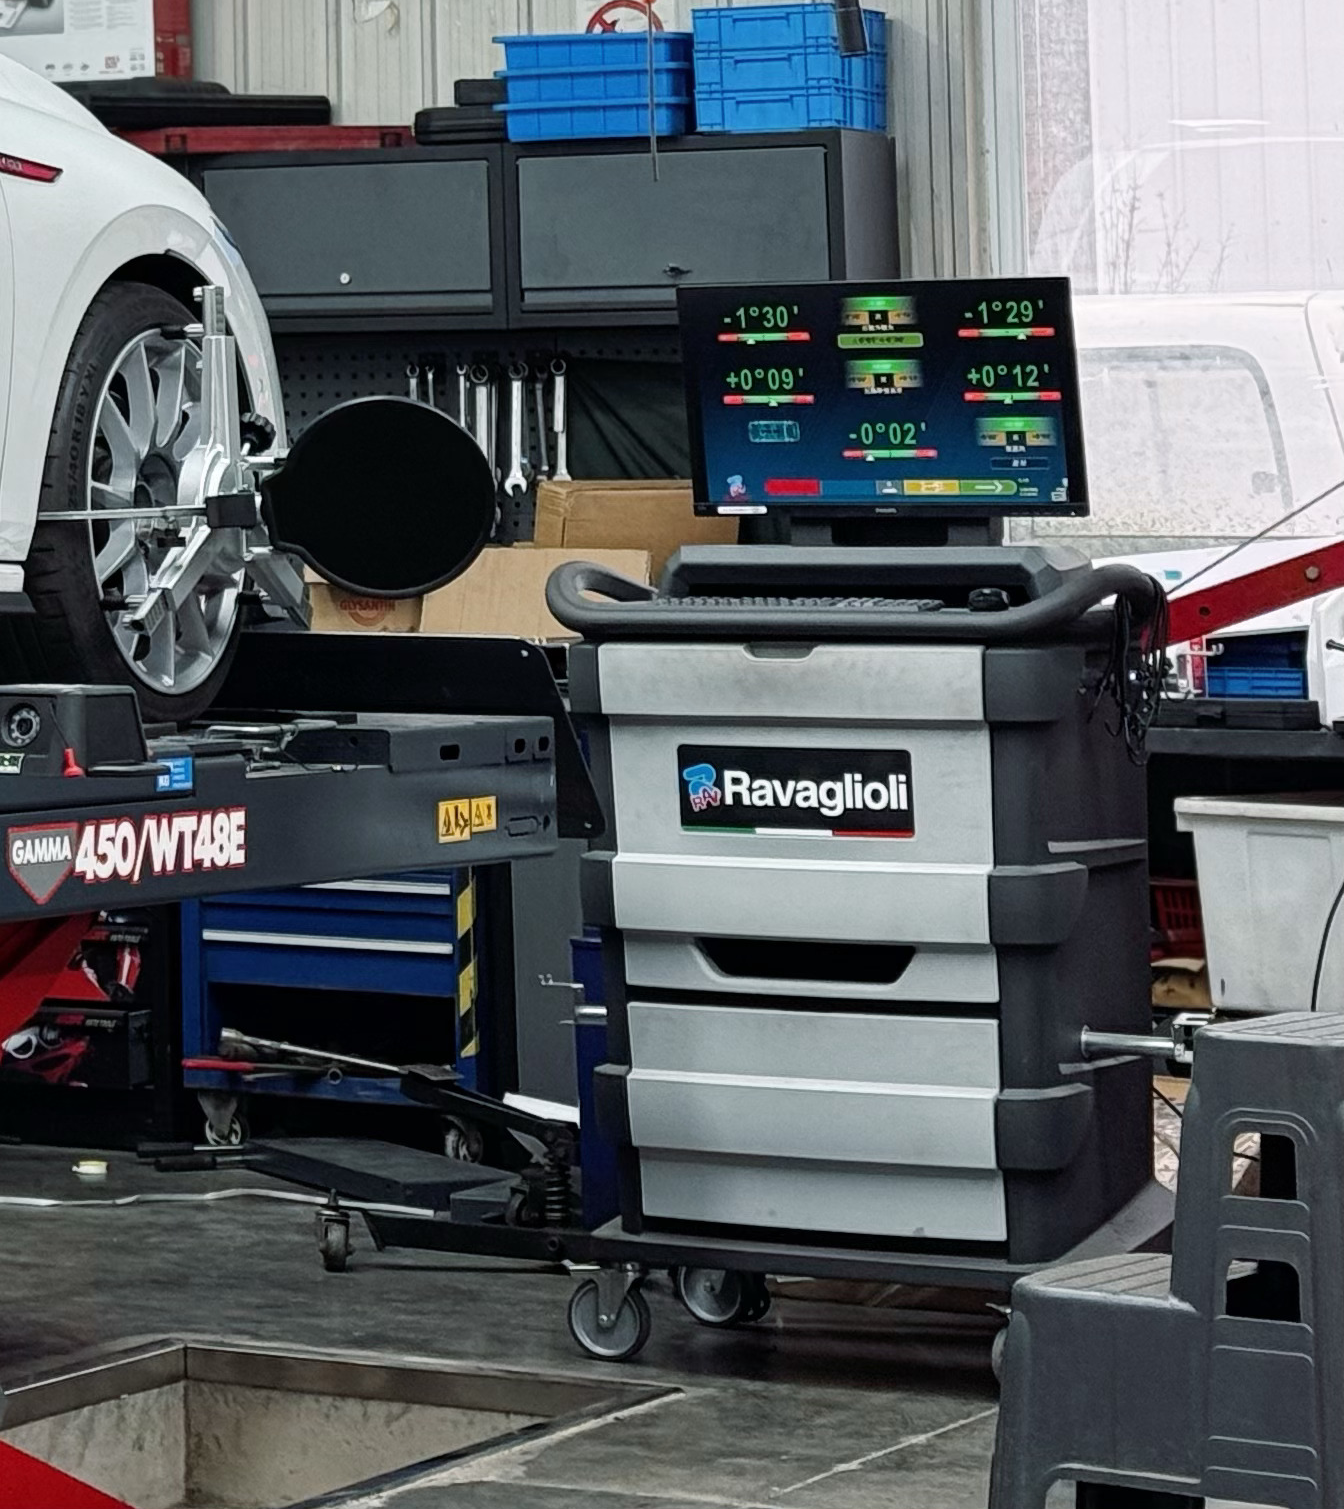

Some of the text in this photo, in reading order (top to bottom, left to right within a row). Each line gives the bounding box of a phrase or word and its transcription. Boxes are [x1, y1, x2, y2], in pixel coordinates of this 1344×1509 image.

[723, 769, 910, 817] Ravaglioli
[11, 835, 73, 866] GAMMA
[74, 809, 247, 883] 450/WT48E
